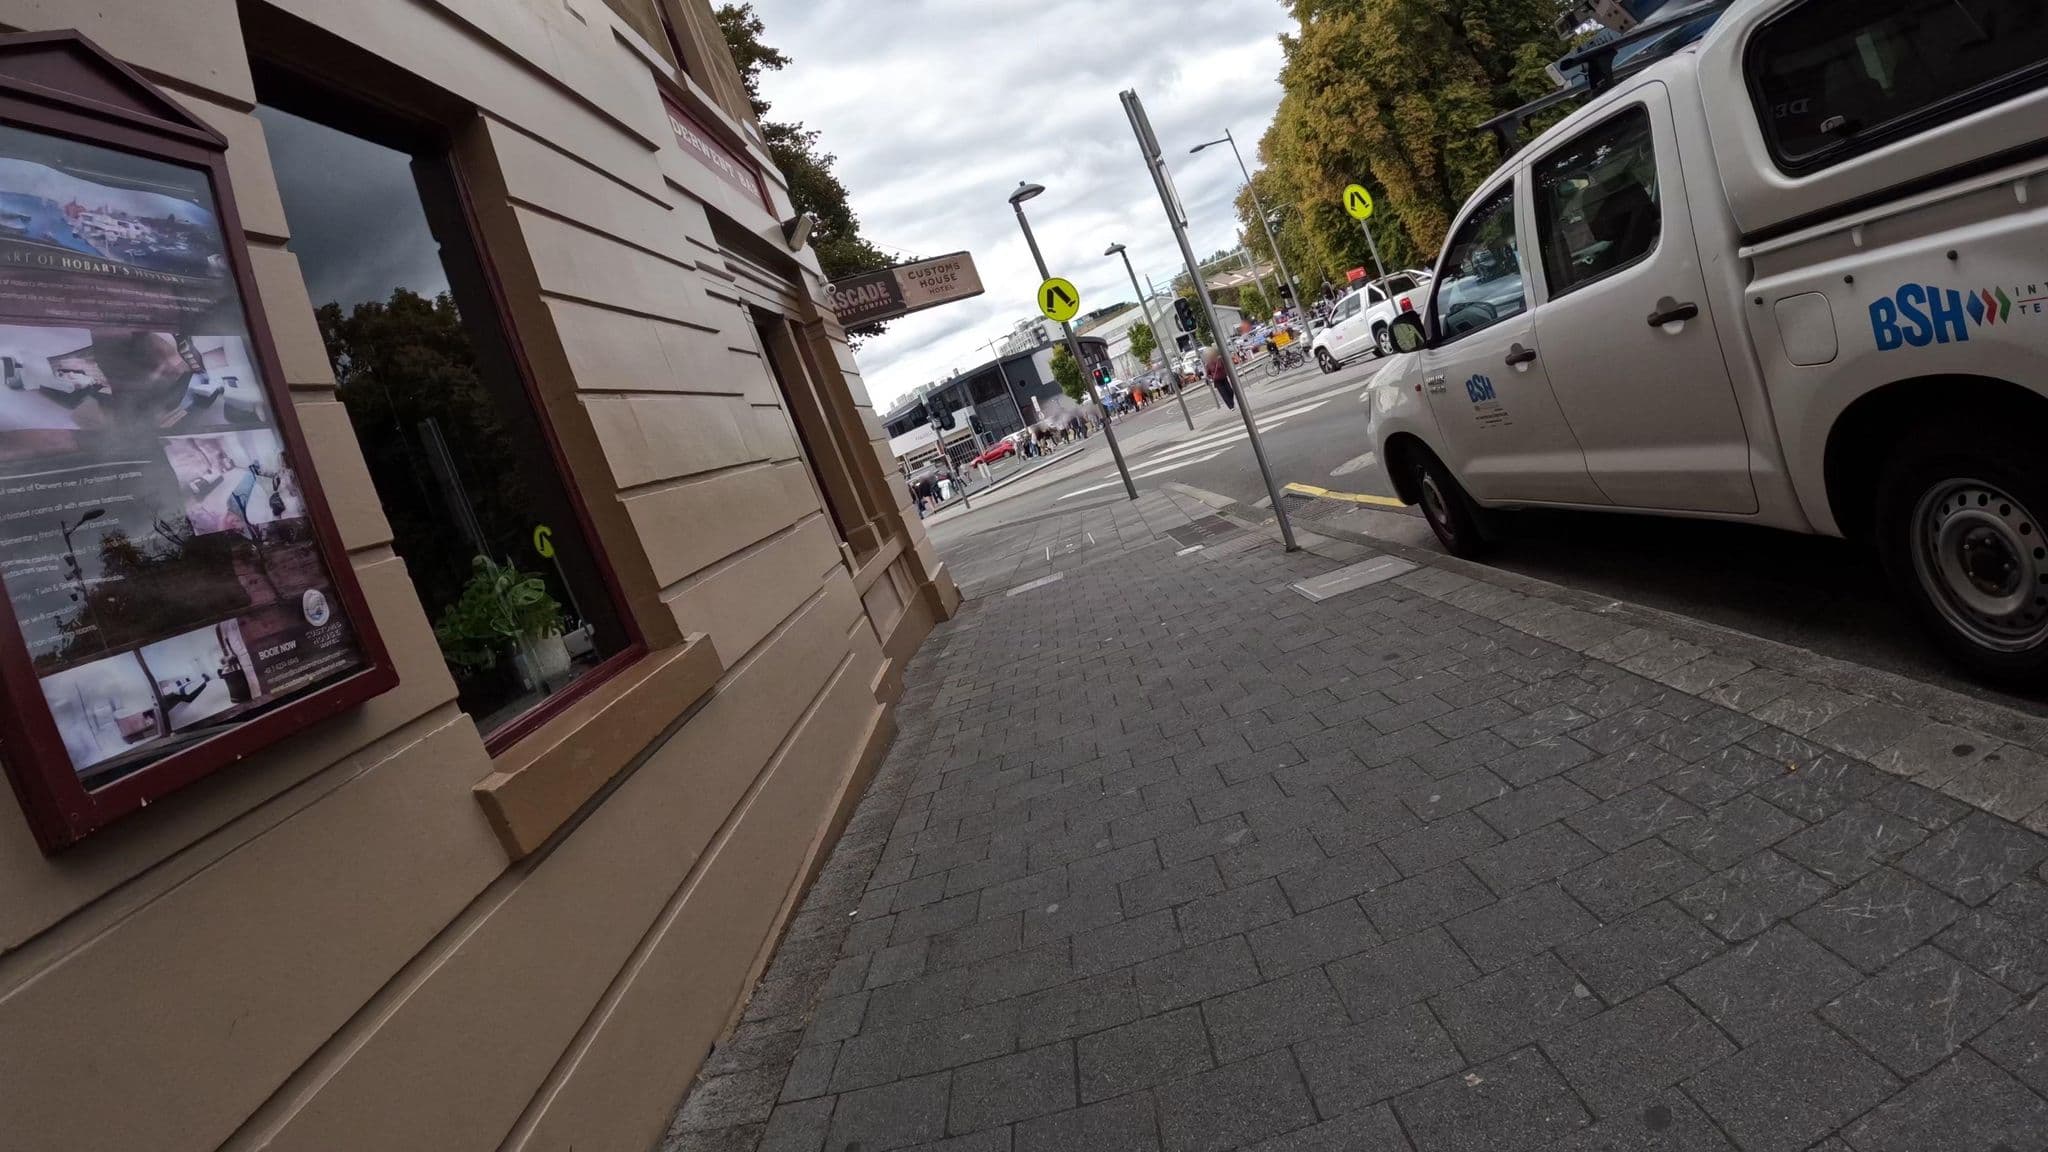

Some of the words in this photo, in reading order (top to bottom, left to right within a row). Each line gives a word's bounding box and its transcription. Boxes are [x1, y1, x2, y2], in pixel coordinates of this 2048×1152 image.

[669, 115, 734, 177] DERWENT
[62, 257, 130, 276] HOBART'S
[908, 262, 960, 280] CUSTOMS
[920, 273, 958, 288] HOUSE
[930, 284, 954, 295] HOTEL
[860, 298, 892, 312] COMPANY
[1869, 283, 1969, 351] BSH
[1465, 374, 1496, 403] BSH
[259, 646, 279, 660] BOOK
[280, 640, 296, 653] NOW
